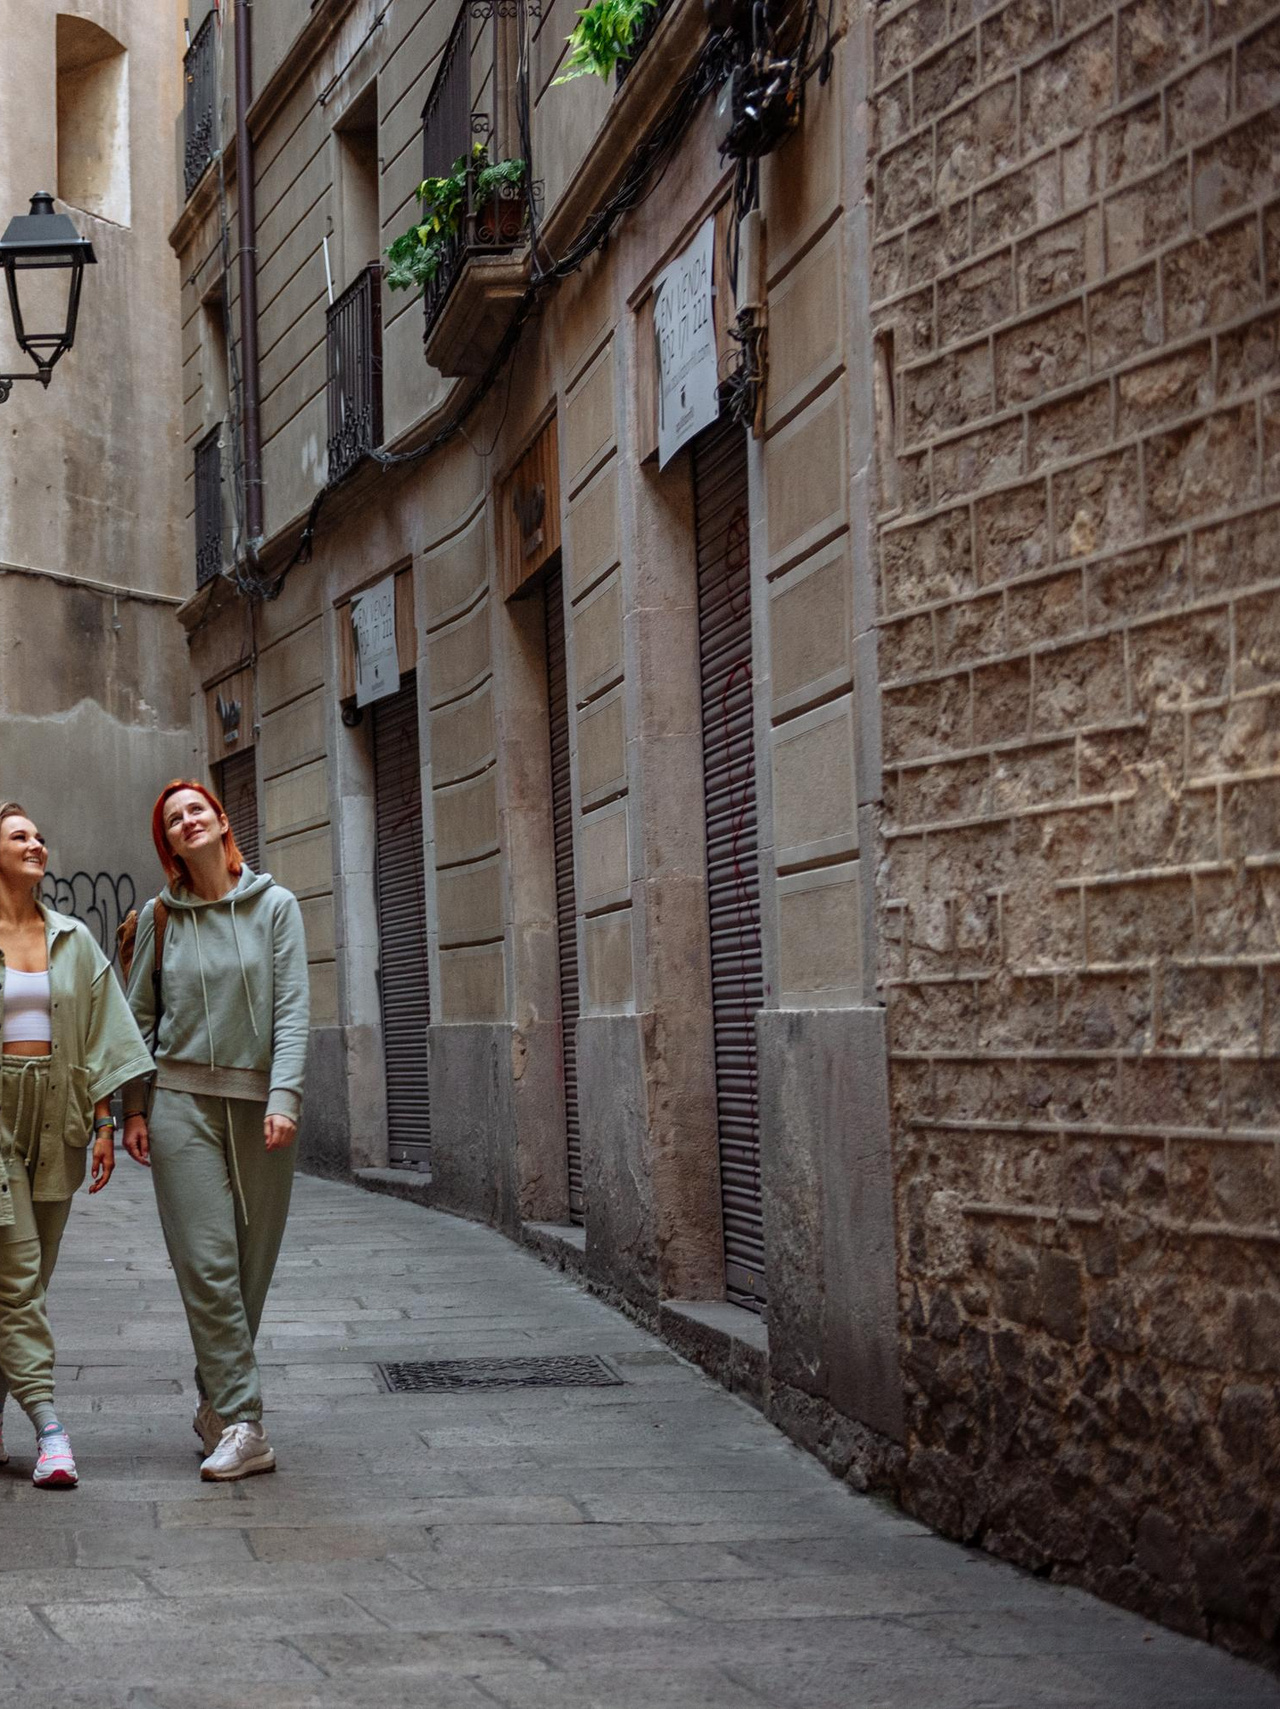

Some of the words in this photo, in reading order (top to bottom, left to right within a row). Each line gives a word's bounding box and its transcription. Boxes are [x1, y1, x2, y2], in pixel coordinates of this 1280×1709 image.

[661, 289, 674, 332] EN
[678, 313, 690, 359] 171
[692, 292, 708, 335] 222
[358, 606, 369, 629] EN
[382, 617, 393, 639] 222
